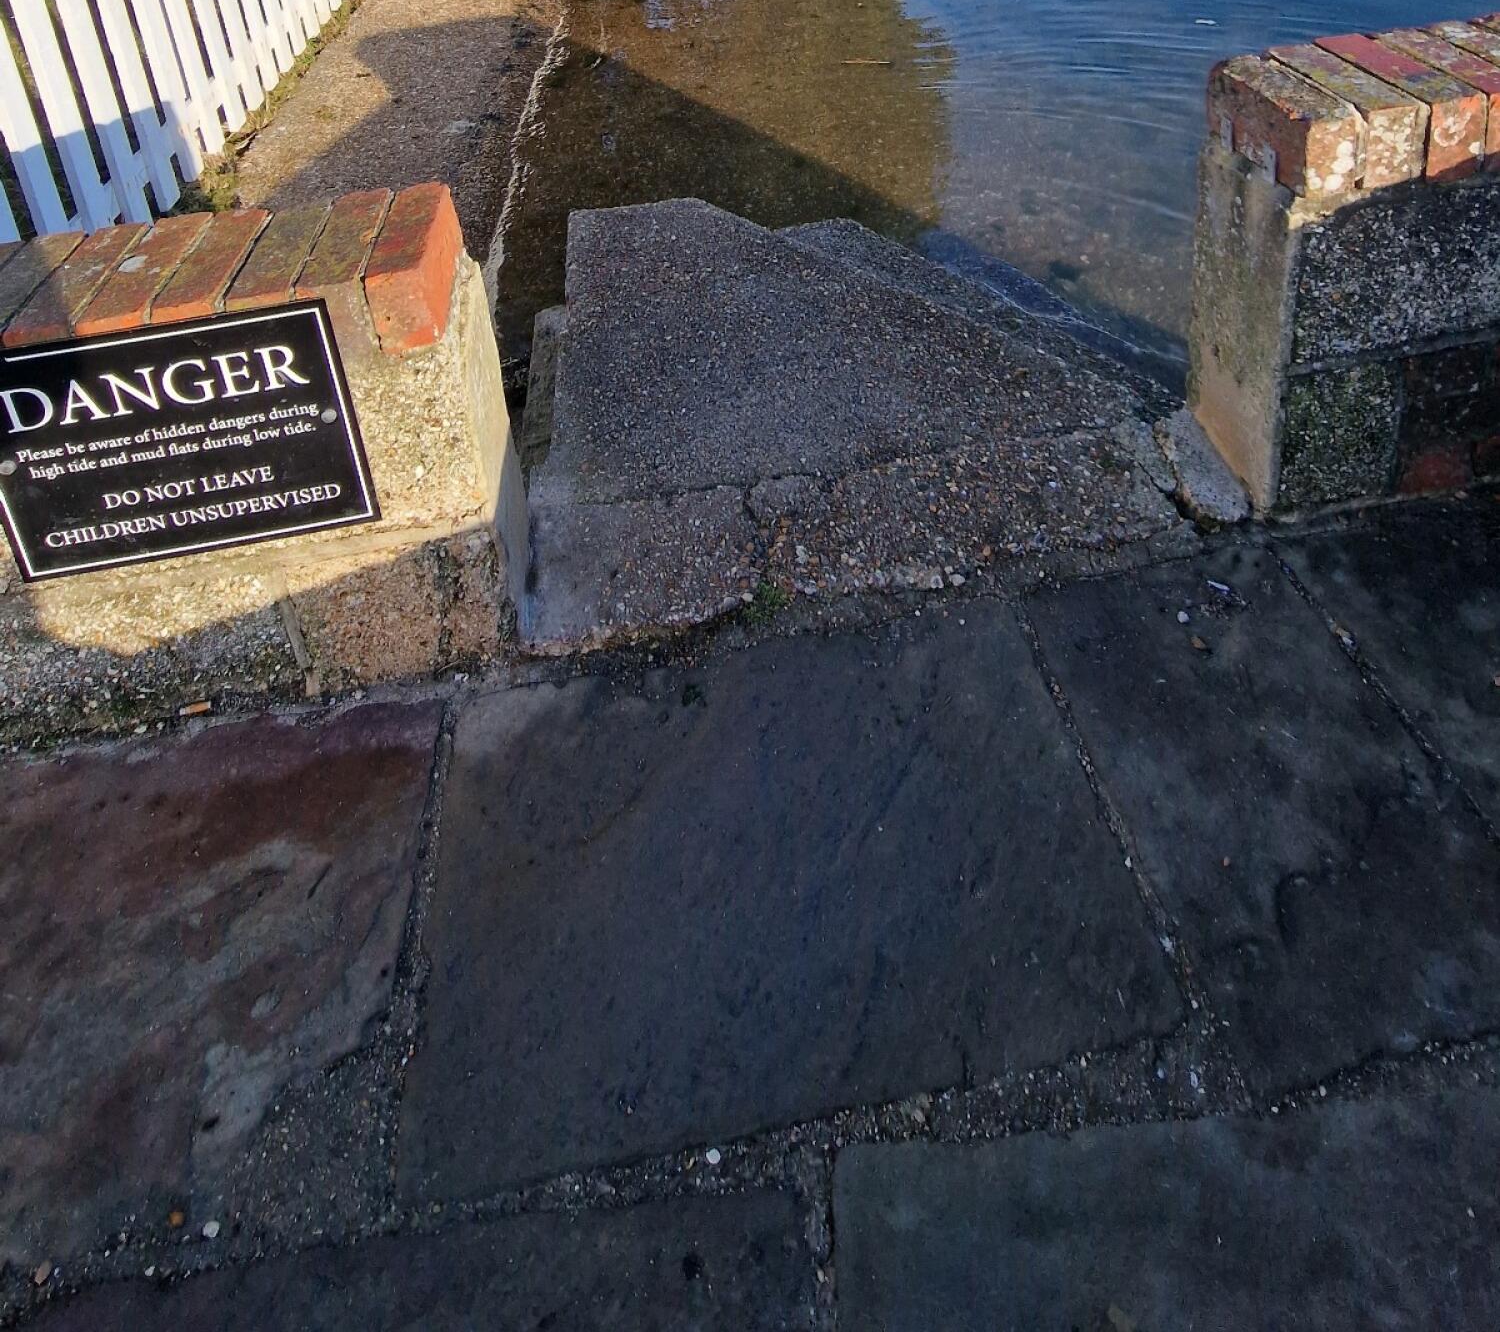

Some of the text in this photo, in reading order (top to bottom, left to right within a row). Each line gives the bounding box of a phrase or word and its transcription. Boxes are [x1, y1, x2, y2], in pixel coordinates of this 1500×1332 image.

[0, 345, 309, 433] DANGER
[16, 403, 320, 464] Please be aware of hidden dangers during
[29, 420, 317, 480] high tide and mud flats during low tide.
[44, 482, 342, 549] CHILDREN UNSUPERVISED
[102, 465, 275, 510] DO NOT LEAVE
